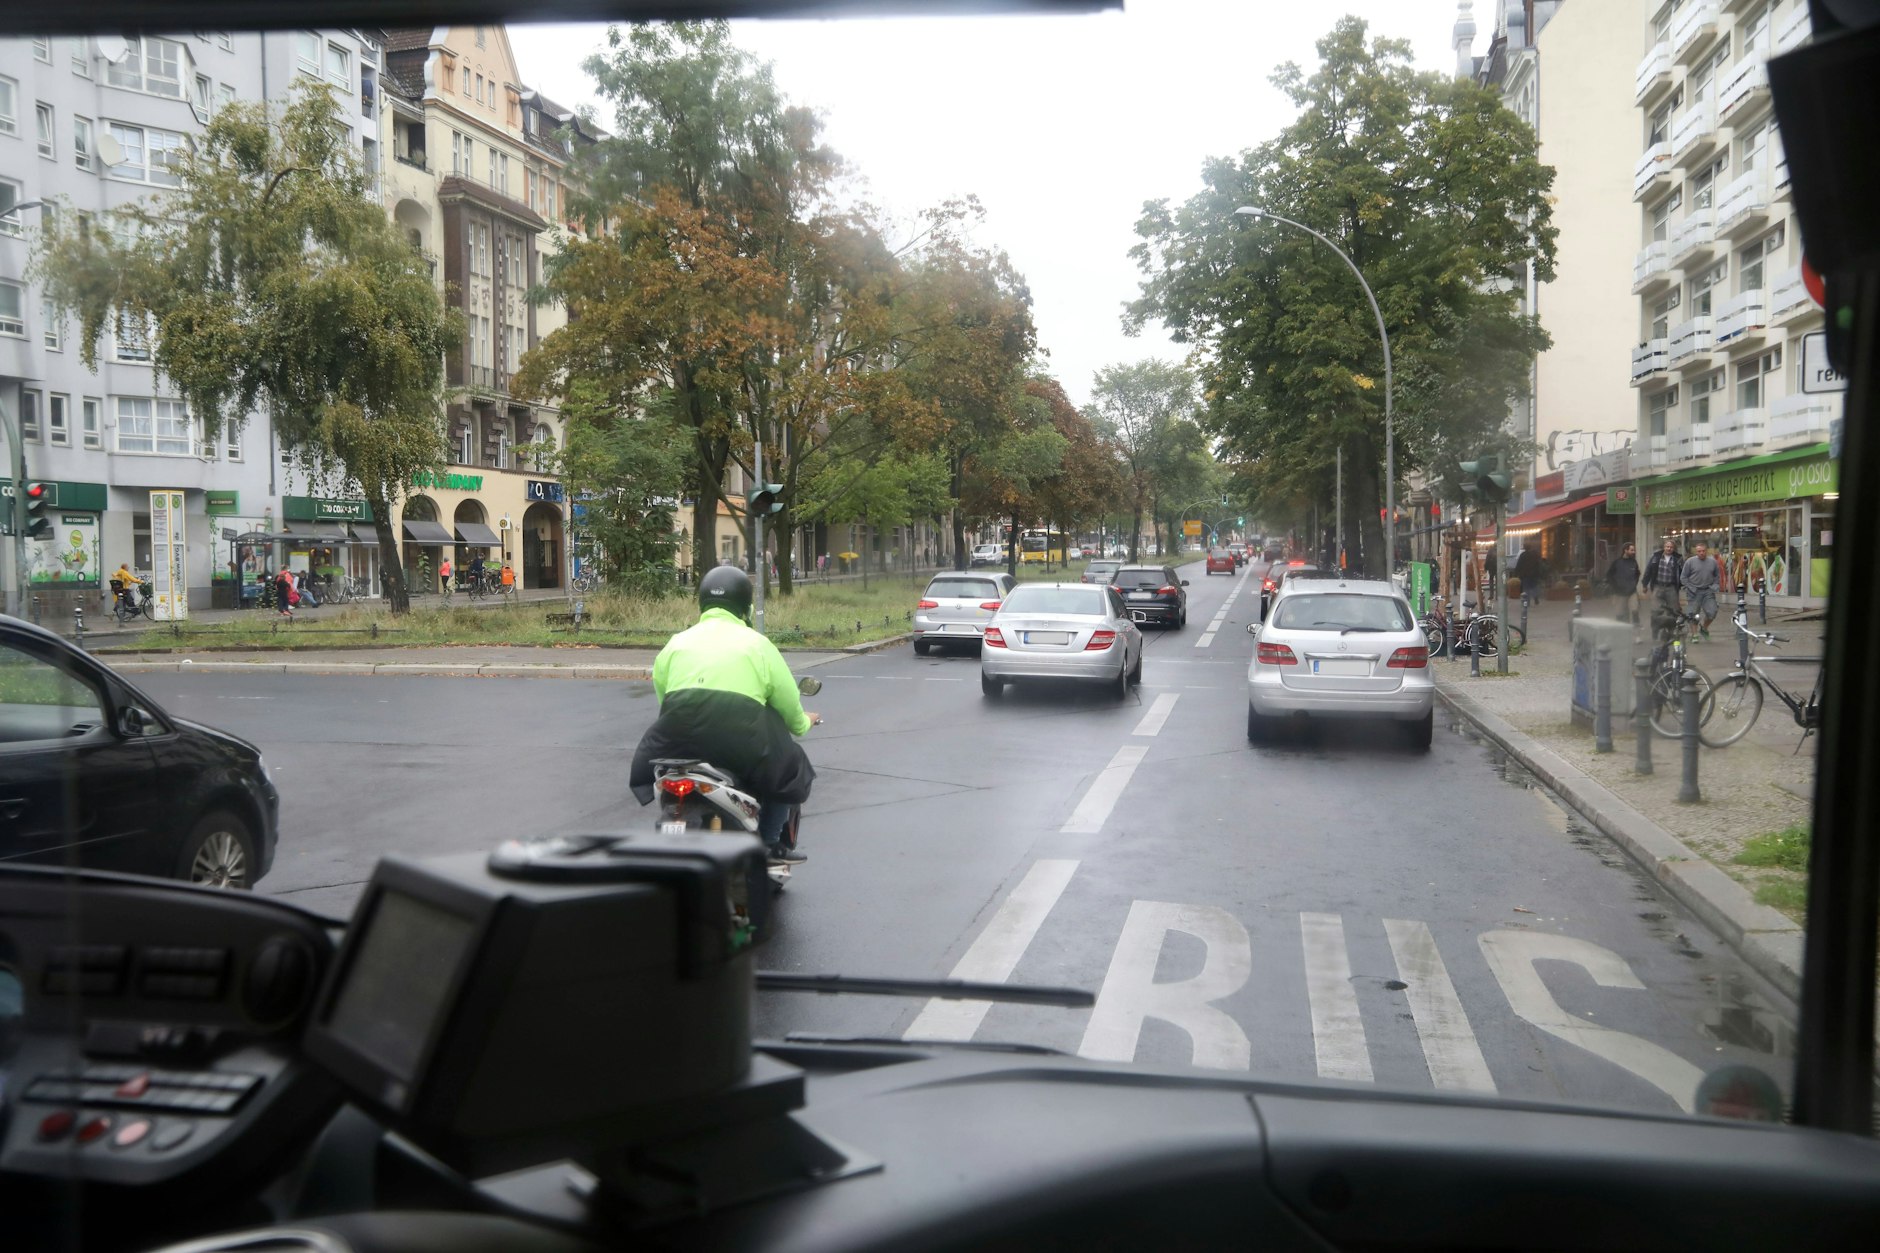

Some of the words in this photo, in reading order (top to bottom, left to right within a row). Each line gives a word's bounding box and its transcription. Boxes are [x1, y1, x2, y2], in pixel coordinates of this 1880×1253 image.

[1689, 482, 1713, 502] asien
[1716, 471, 1775, 503] supermarkt
[1789, 466, 1804, 497] go
[1807, 461, 1832, 485] asia
